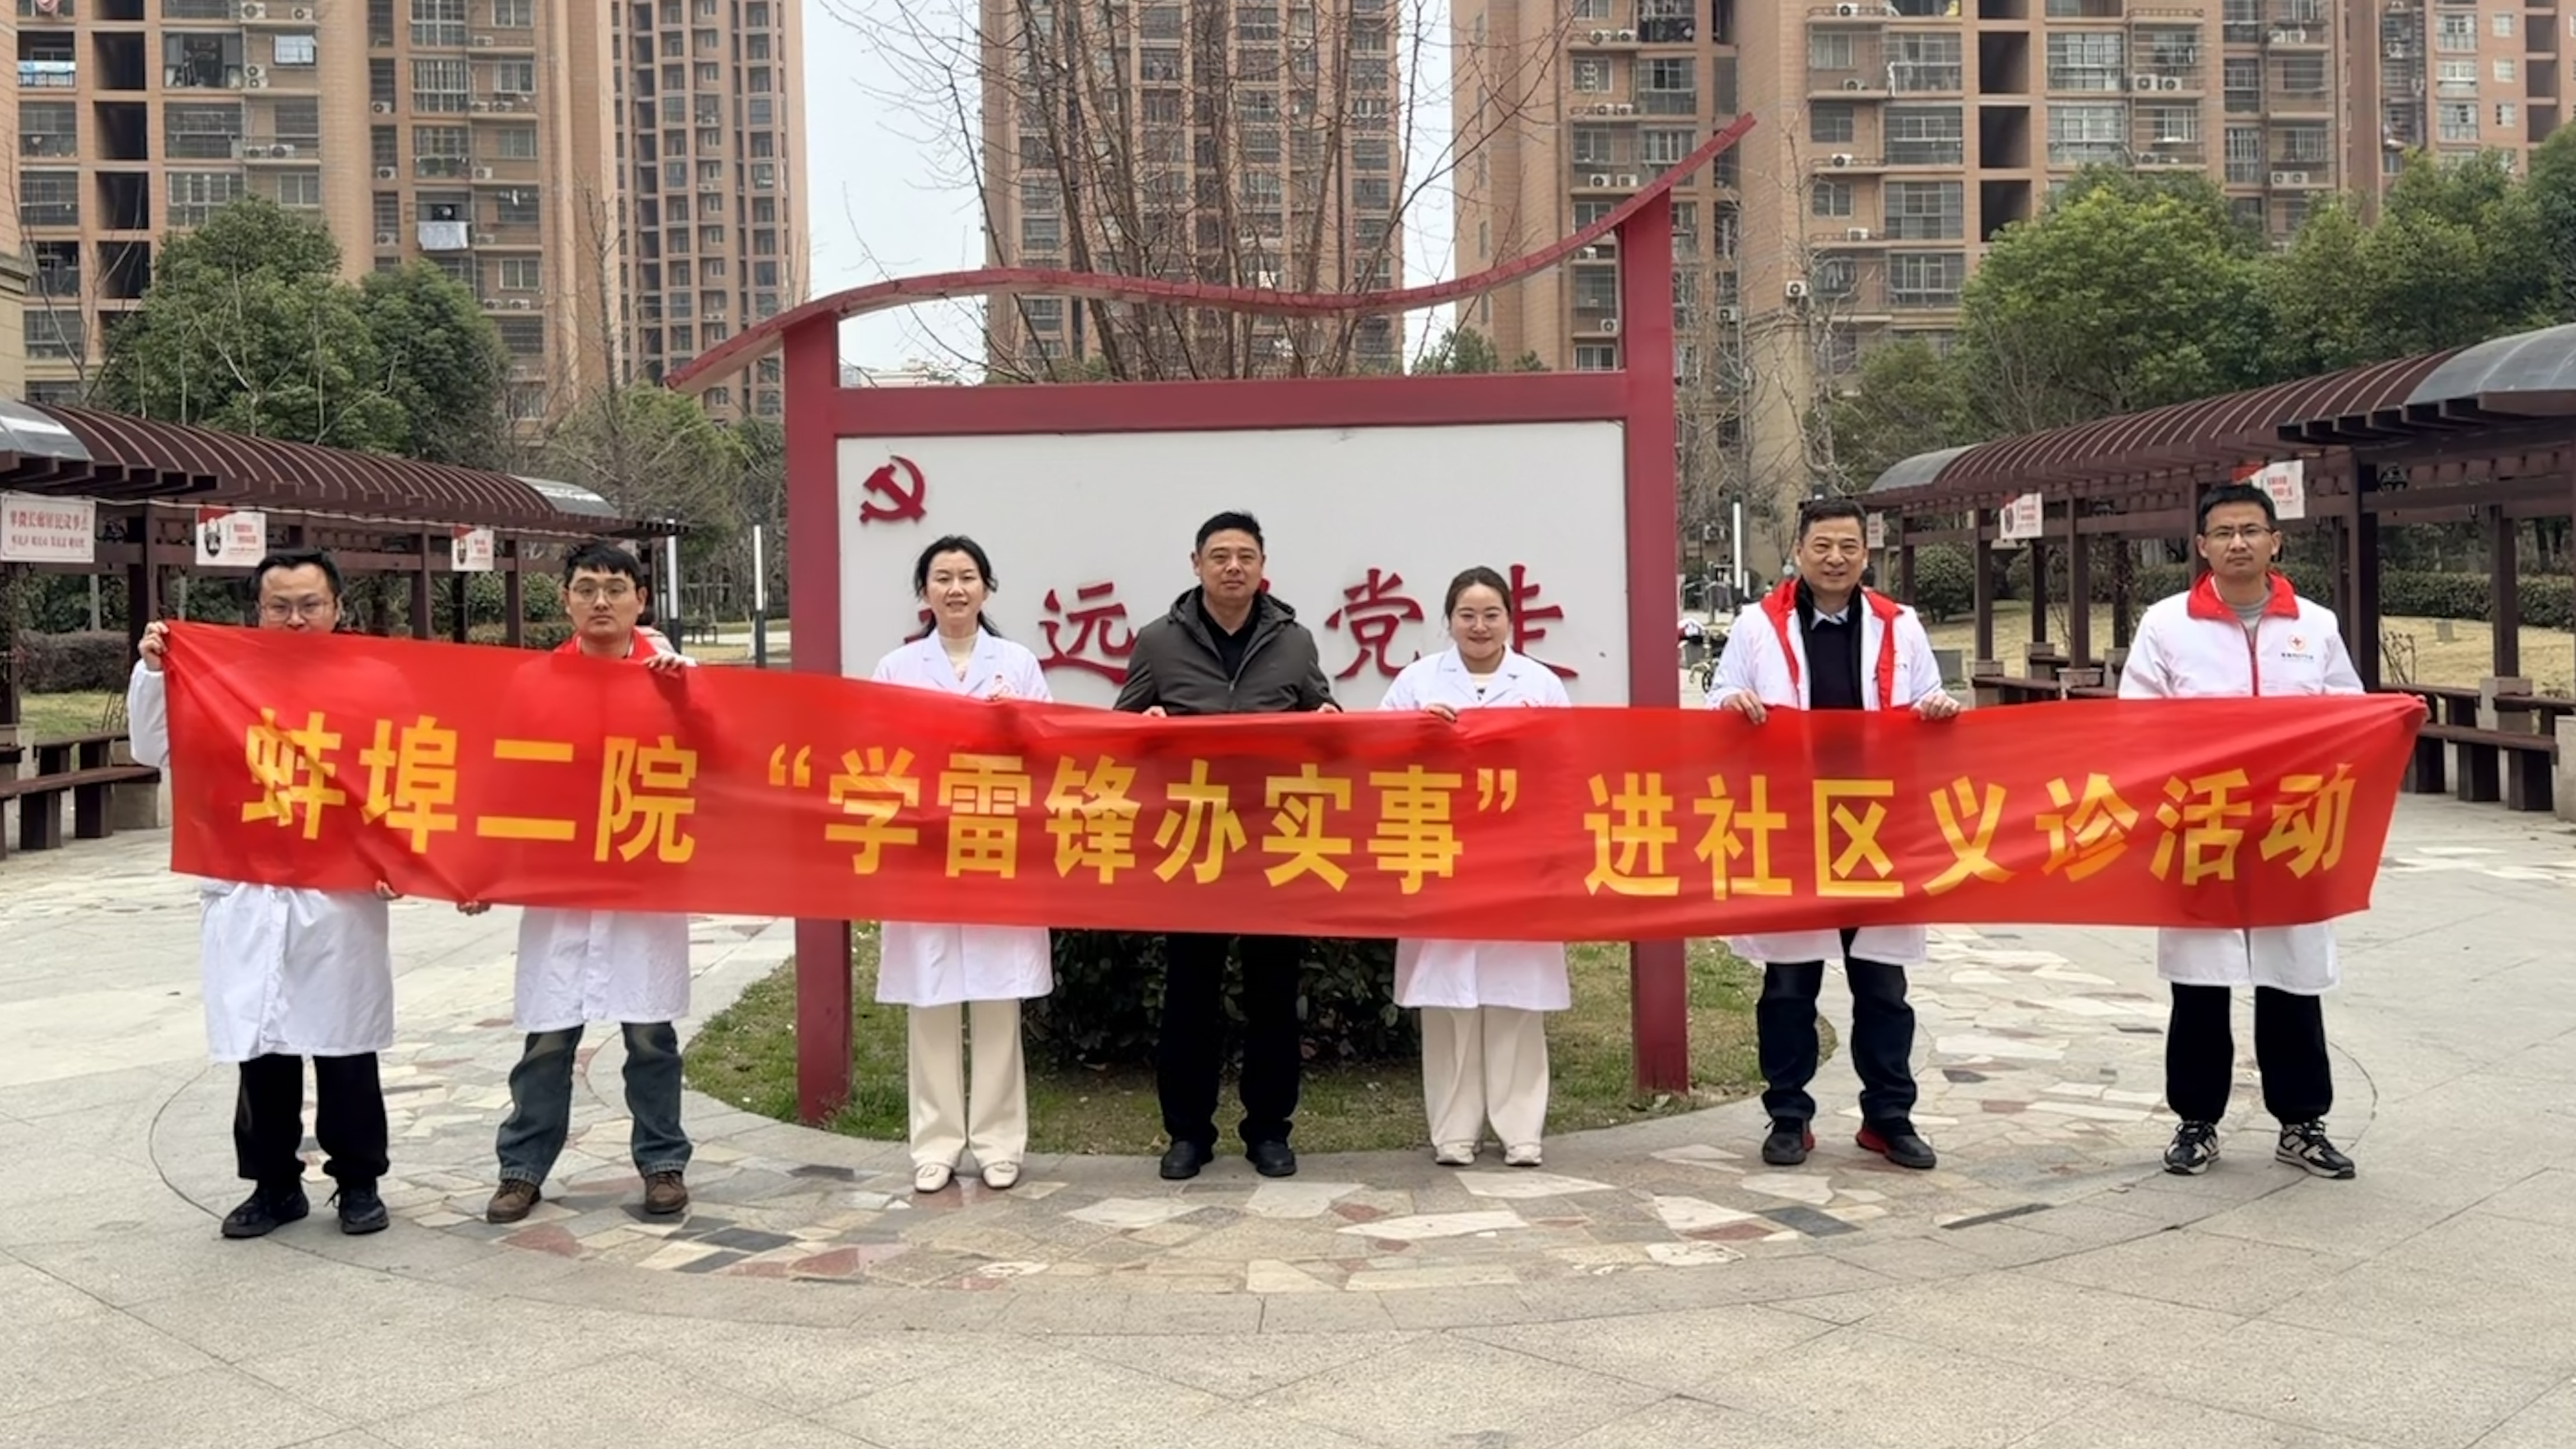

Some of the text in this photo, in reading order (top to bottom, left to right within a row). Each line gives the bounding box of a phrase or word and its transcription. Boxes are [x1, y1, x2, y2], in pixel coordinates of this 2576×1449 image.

[241, 707, 2357, 900] 蚌埠二院 “学雷锋办实事” 进社区义诊活动
